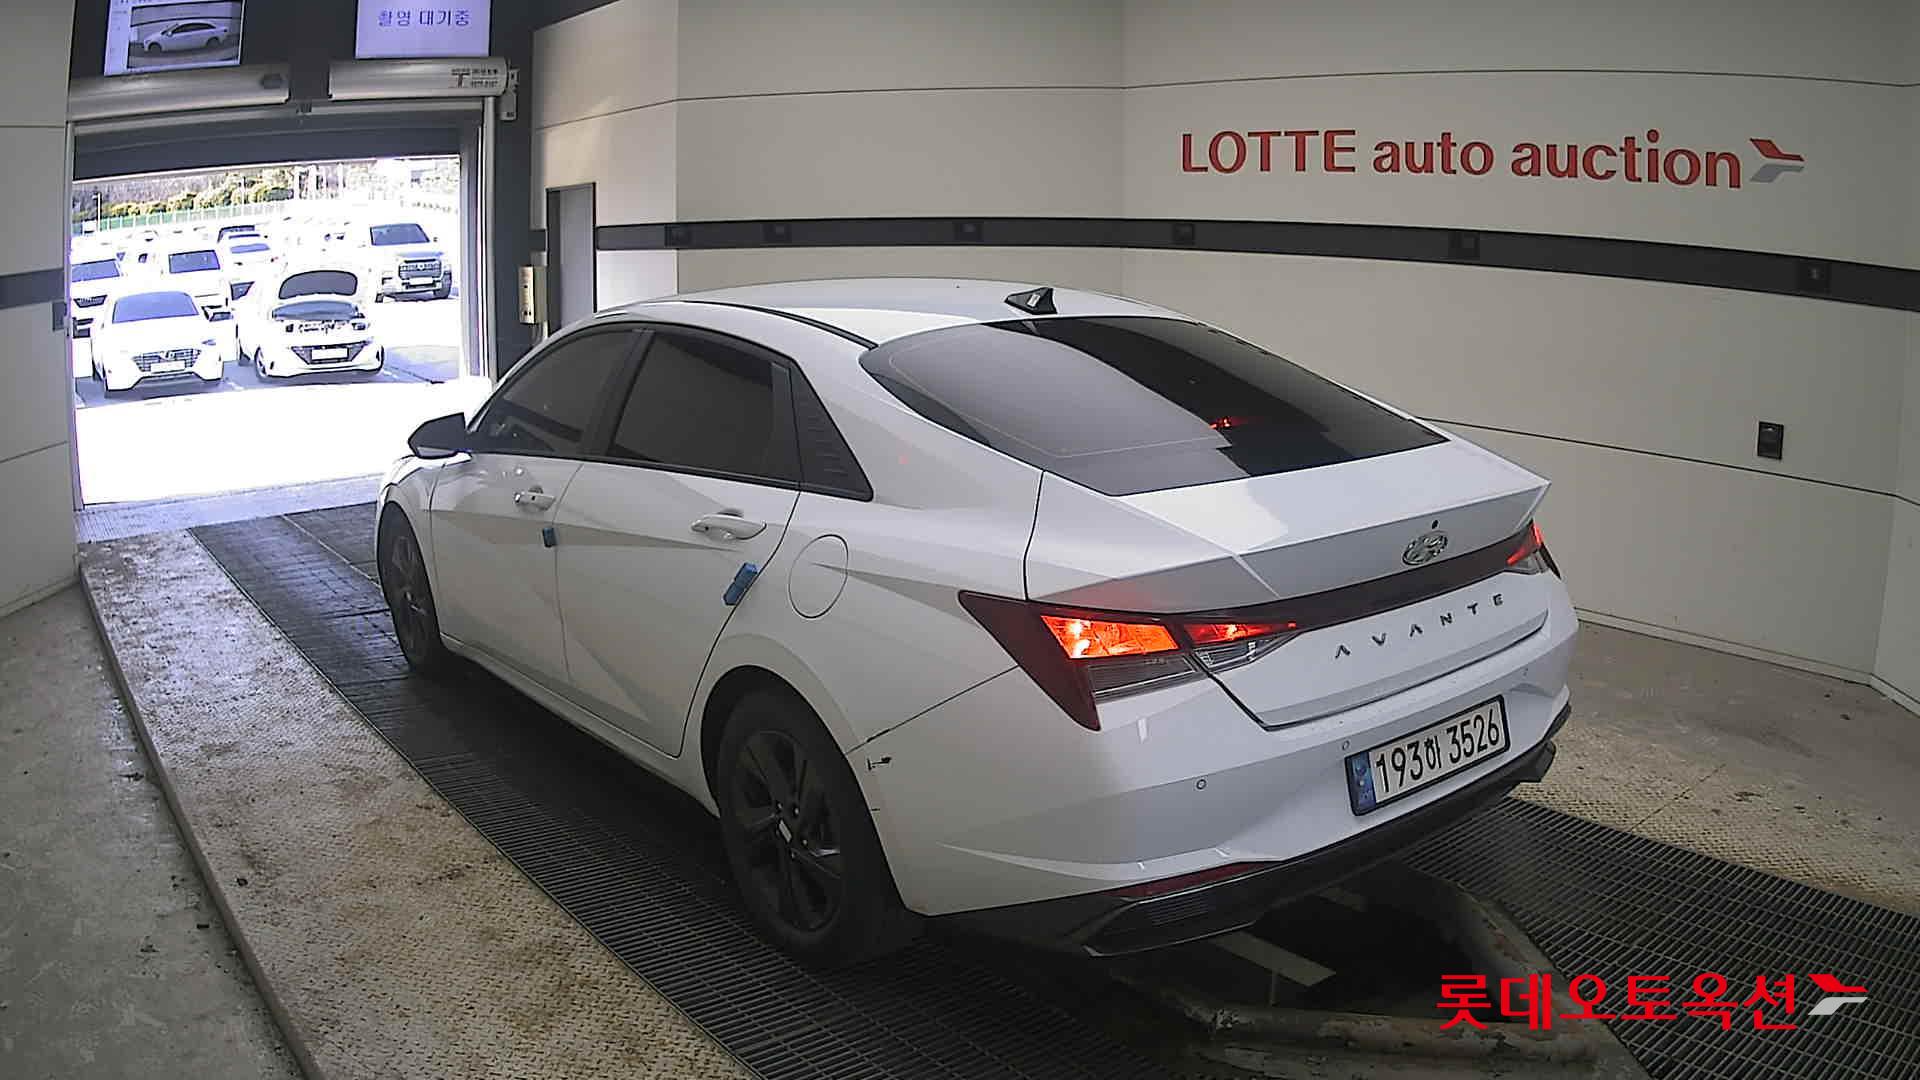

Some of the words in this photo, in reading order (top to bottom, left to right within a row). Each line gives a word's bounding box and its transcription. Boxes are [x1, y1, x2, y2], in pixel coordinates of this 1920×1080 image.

[419, 9, 469, 27] 대기중
[1182, 130, 1356, 172] LOTTE
[1373, 132, 1494, 175] auto
[1511, 129, 1741, 188] auction
[1336, 595, 1503, 659] AVANTE
[1376, 735, 1442, 793] 193하
[1446, 708, 1500, 764] 3526
